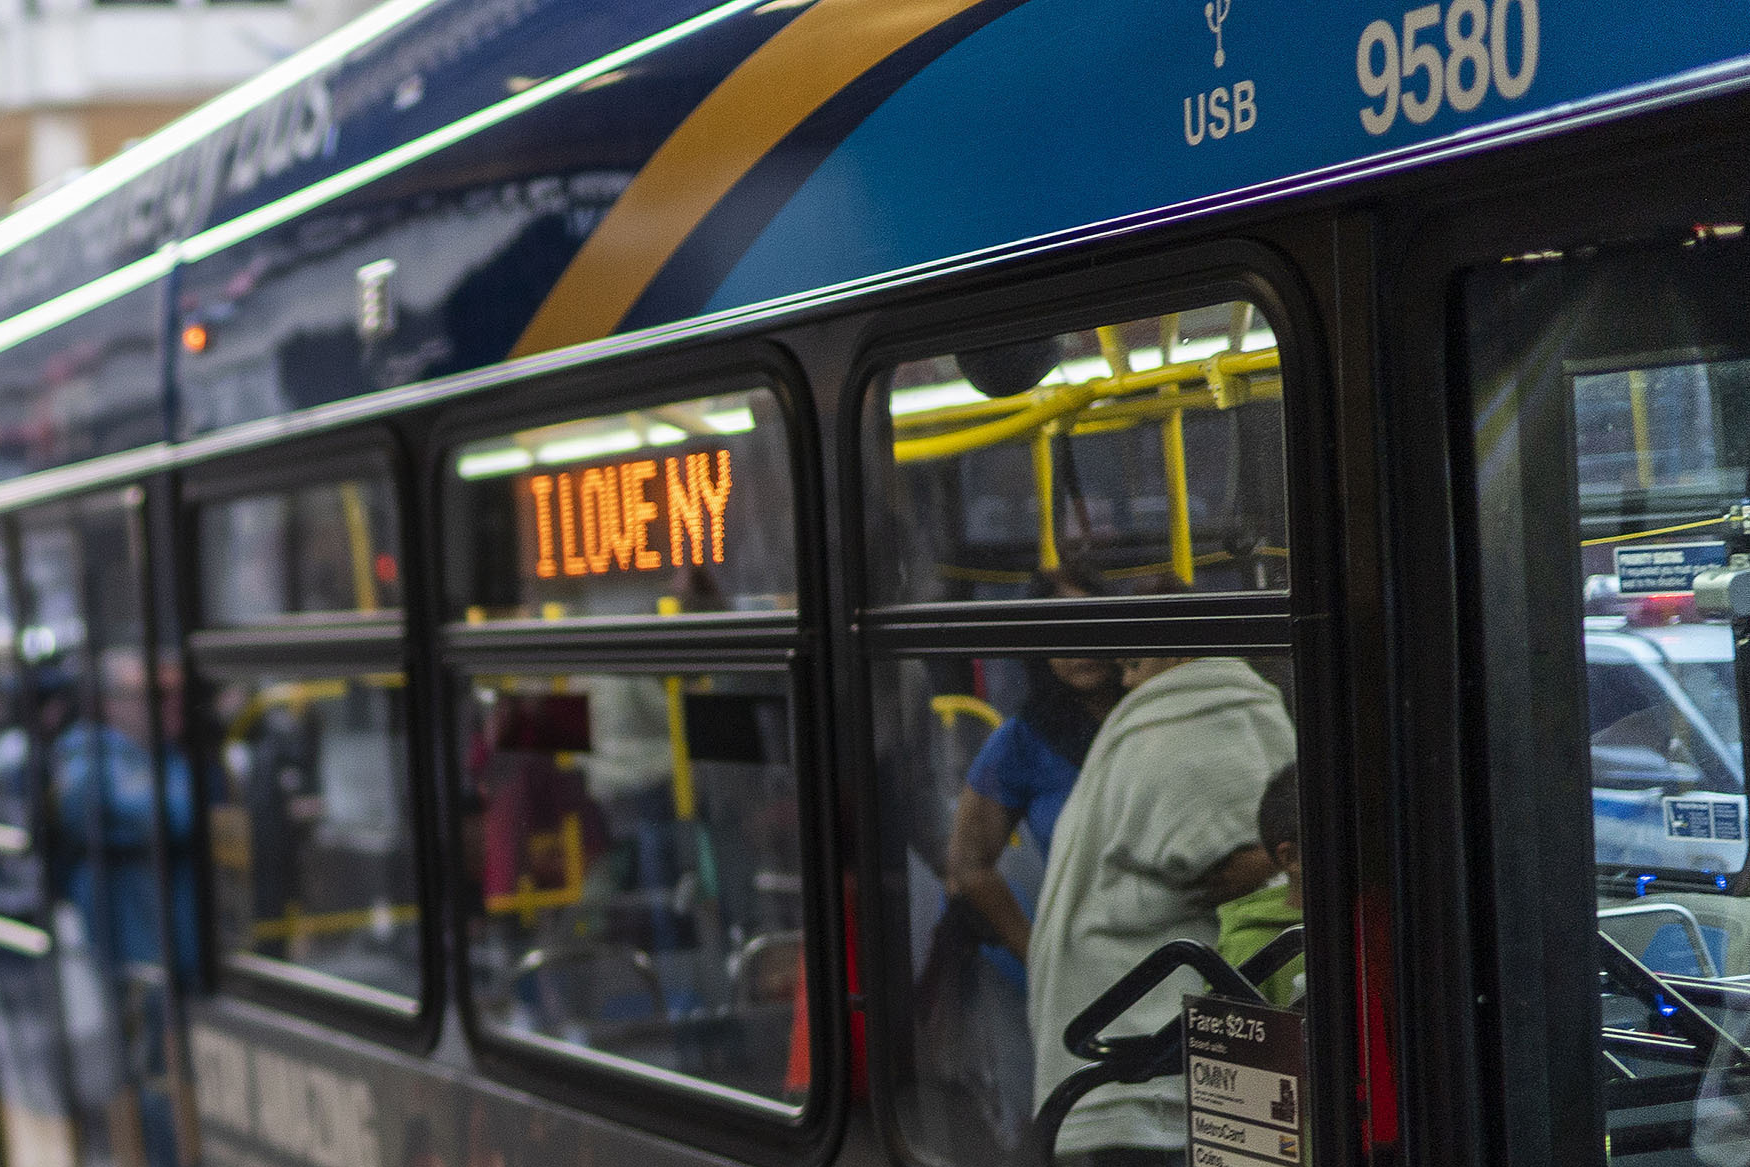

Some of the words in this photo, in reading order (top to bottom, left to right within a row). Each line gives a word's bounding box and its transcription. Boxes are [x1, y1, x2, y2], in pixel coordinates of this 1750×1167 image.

[1356, 0, 1539, 136] 9580
[1184, 80, 1258, 146] USB
[531, 475, 558, 578] I
[558, 459, 662, 577] LOVE
[665, 449, 732, 568] NY
[1187, 1007, 1224, 1035] Fare:
[1225, 1012, 1266, 1043] $2.75
[1193, 1061, 1238, 1092] OMNY
[1195, 1115, 1246, 1144] MetroCard
[1195, 1147, 1224, 1167] Coins
